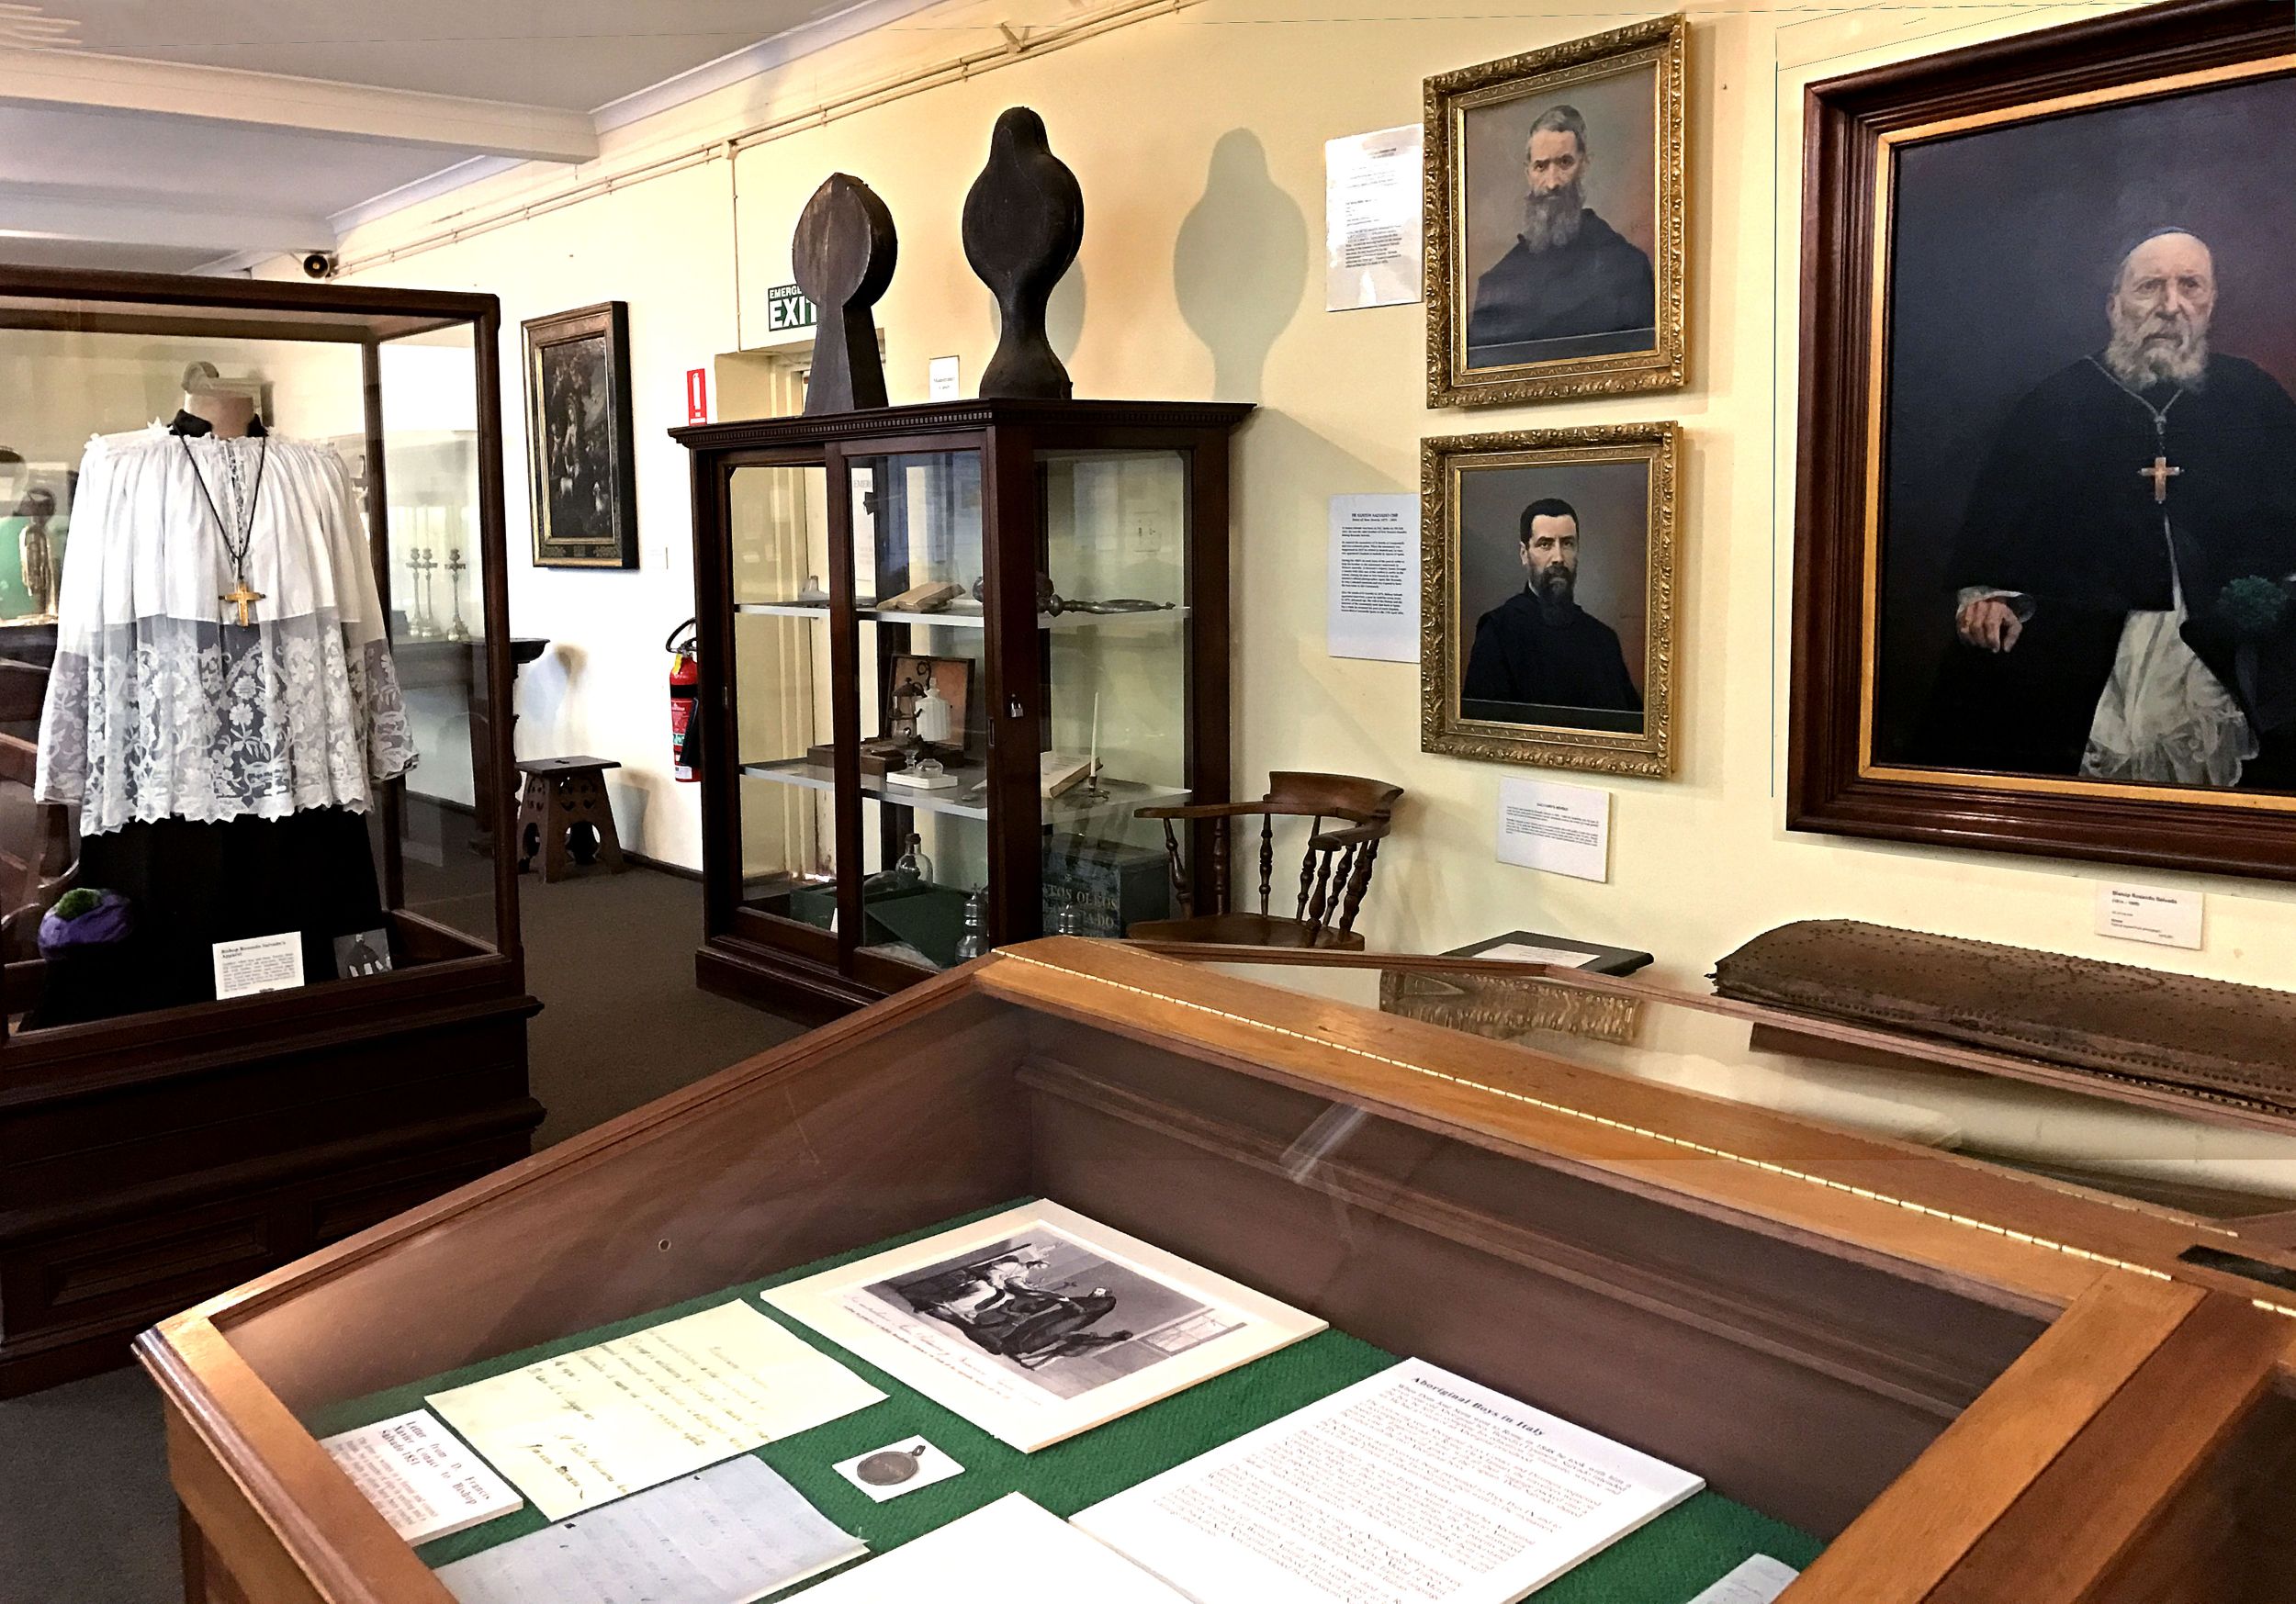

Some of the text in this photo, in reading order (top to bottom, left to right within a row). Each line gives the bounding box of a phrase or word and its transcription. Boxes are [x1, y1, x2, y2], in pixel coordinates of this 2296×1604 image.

[770, 286, 802, 298] EMERGE
[770, 296, 816, 329] EXIT
[1411, 1377, 1545, 1436] Aboriginal Boys in Italy
[381, 1430, 404, 1452] Salvado
[406, 1420, 427, 1438] Letter
[430, 1443, 446, 1458] from
[465, 1476, 490, 1500] Francis
[441, 1471, 451, 1479] to
[452, 1482, 478, 1505] Bishop
